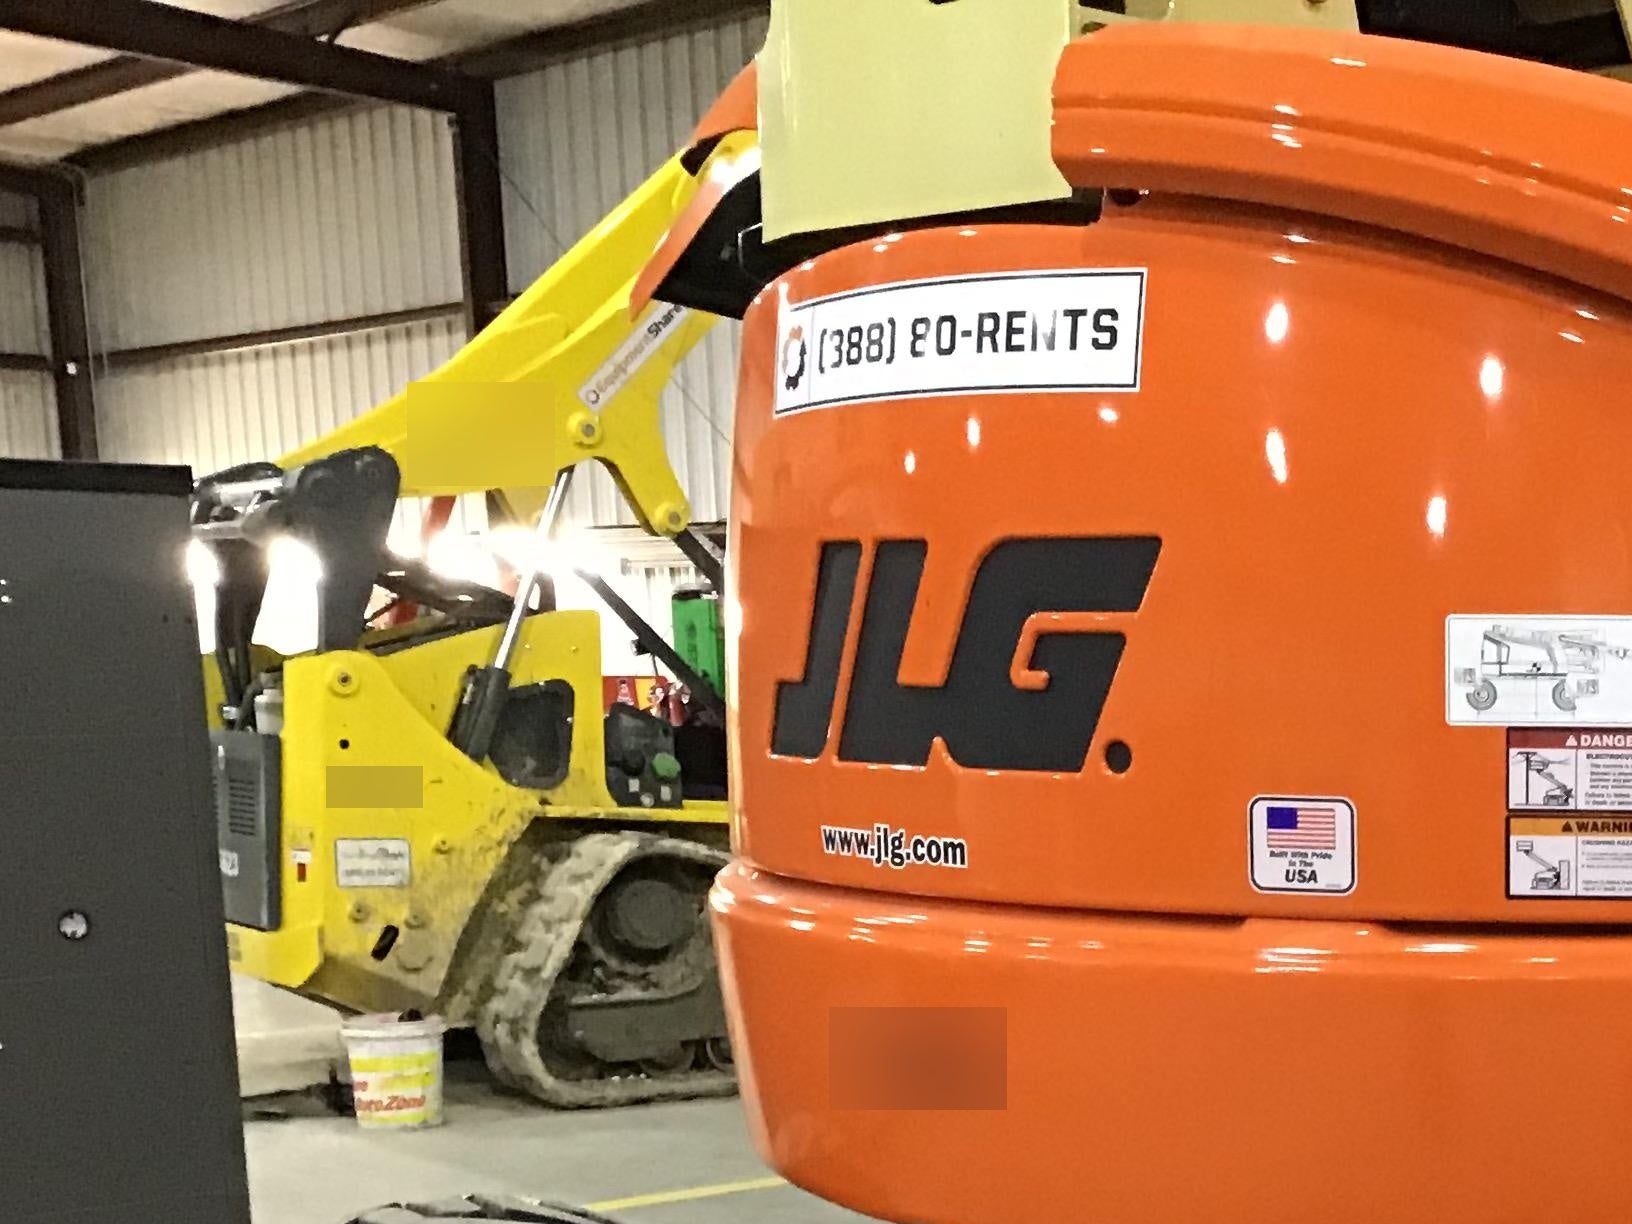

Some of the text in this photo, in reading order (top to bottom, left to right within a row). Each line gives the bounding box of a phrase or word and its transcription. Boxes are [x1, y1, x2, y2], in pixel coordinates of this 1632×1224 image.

[910, 308, 1119, 358] 80-RENTS
[822, 825, 967, 869] www.jlg.com
[1311, 852, 1333, 860] Pride
[1284, 869, 1318, 884] USA
